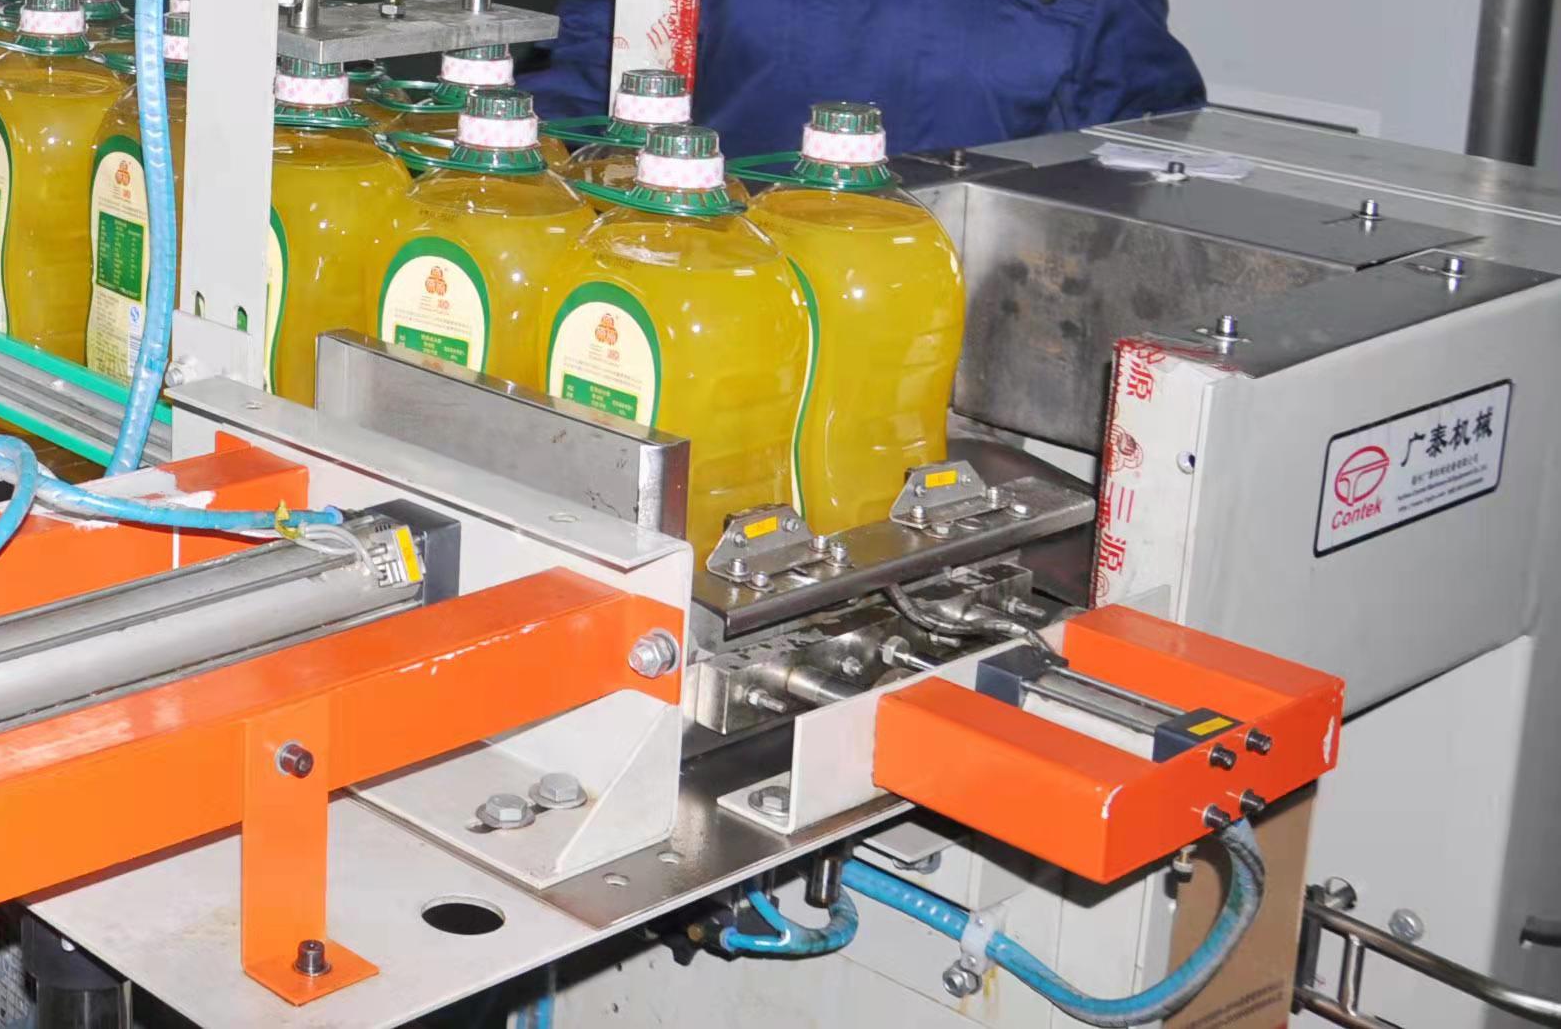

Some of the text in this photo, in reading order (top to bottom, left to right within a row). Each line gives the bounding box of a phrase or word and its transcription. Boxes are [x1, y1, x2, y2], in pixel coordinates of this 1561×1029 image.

[1401, 407, 1493, 467] 广泰机械
[1332, 498, 1383, 530] Contek
